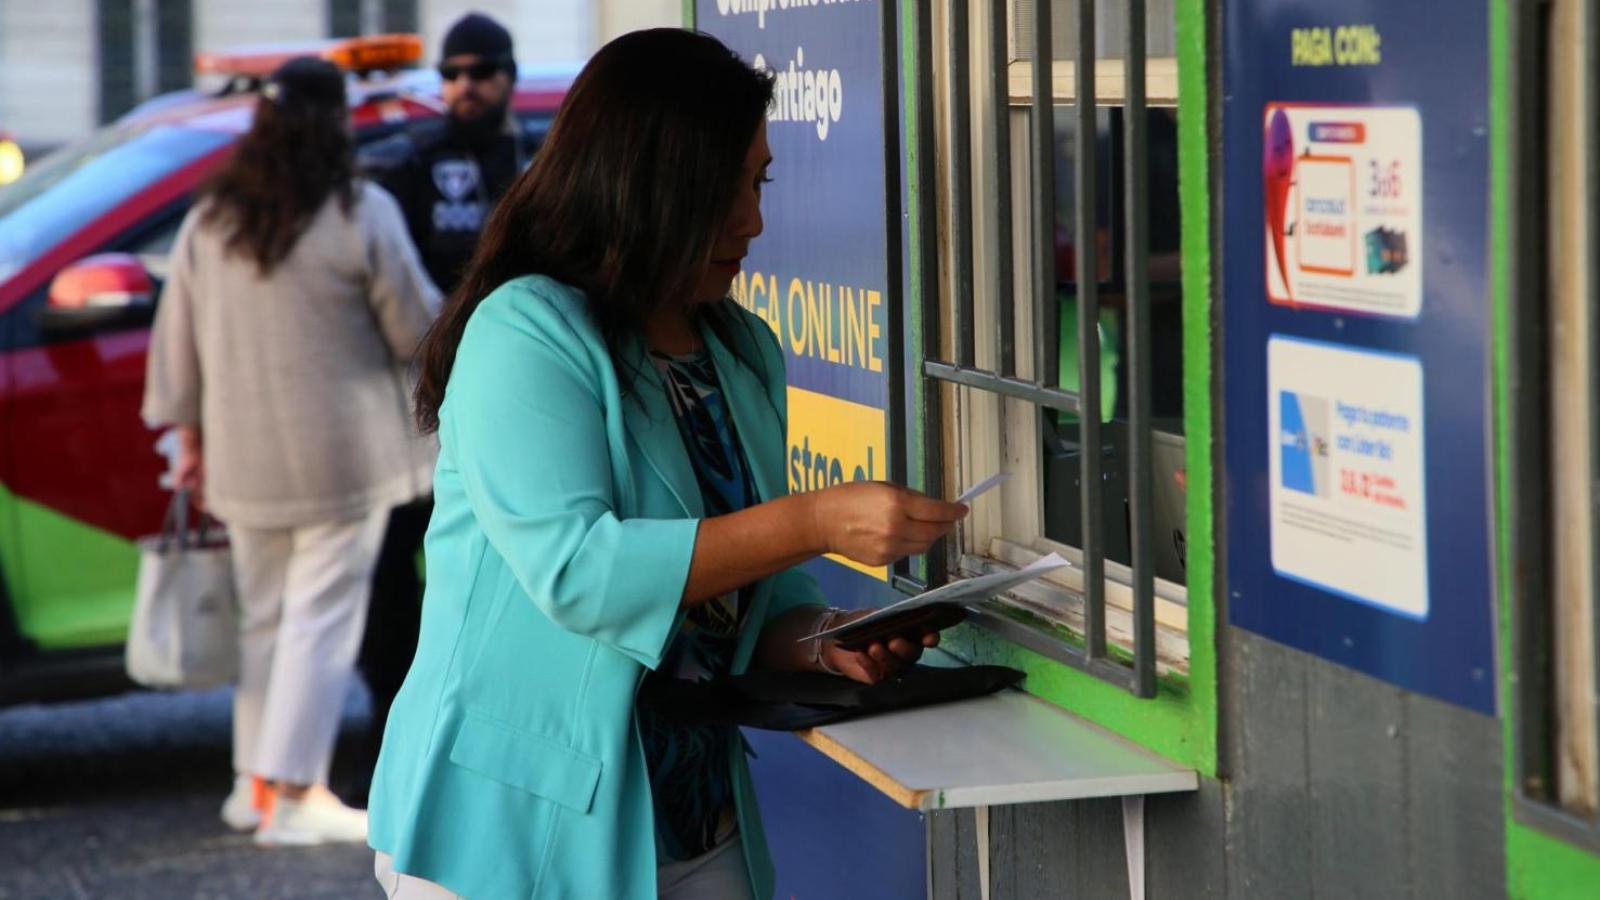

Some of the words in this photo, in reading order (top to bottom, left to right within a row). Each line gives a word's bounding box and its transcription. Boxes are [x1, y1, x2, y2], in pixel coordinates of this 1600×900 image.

[753, 45, 843, 141] antiago
[1291, 26, 1333, 66] PAGA
[731, 269, 784, 351] AGA
[787, 276, 883, 373] ONLINE
